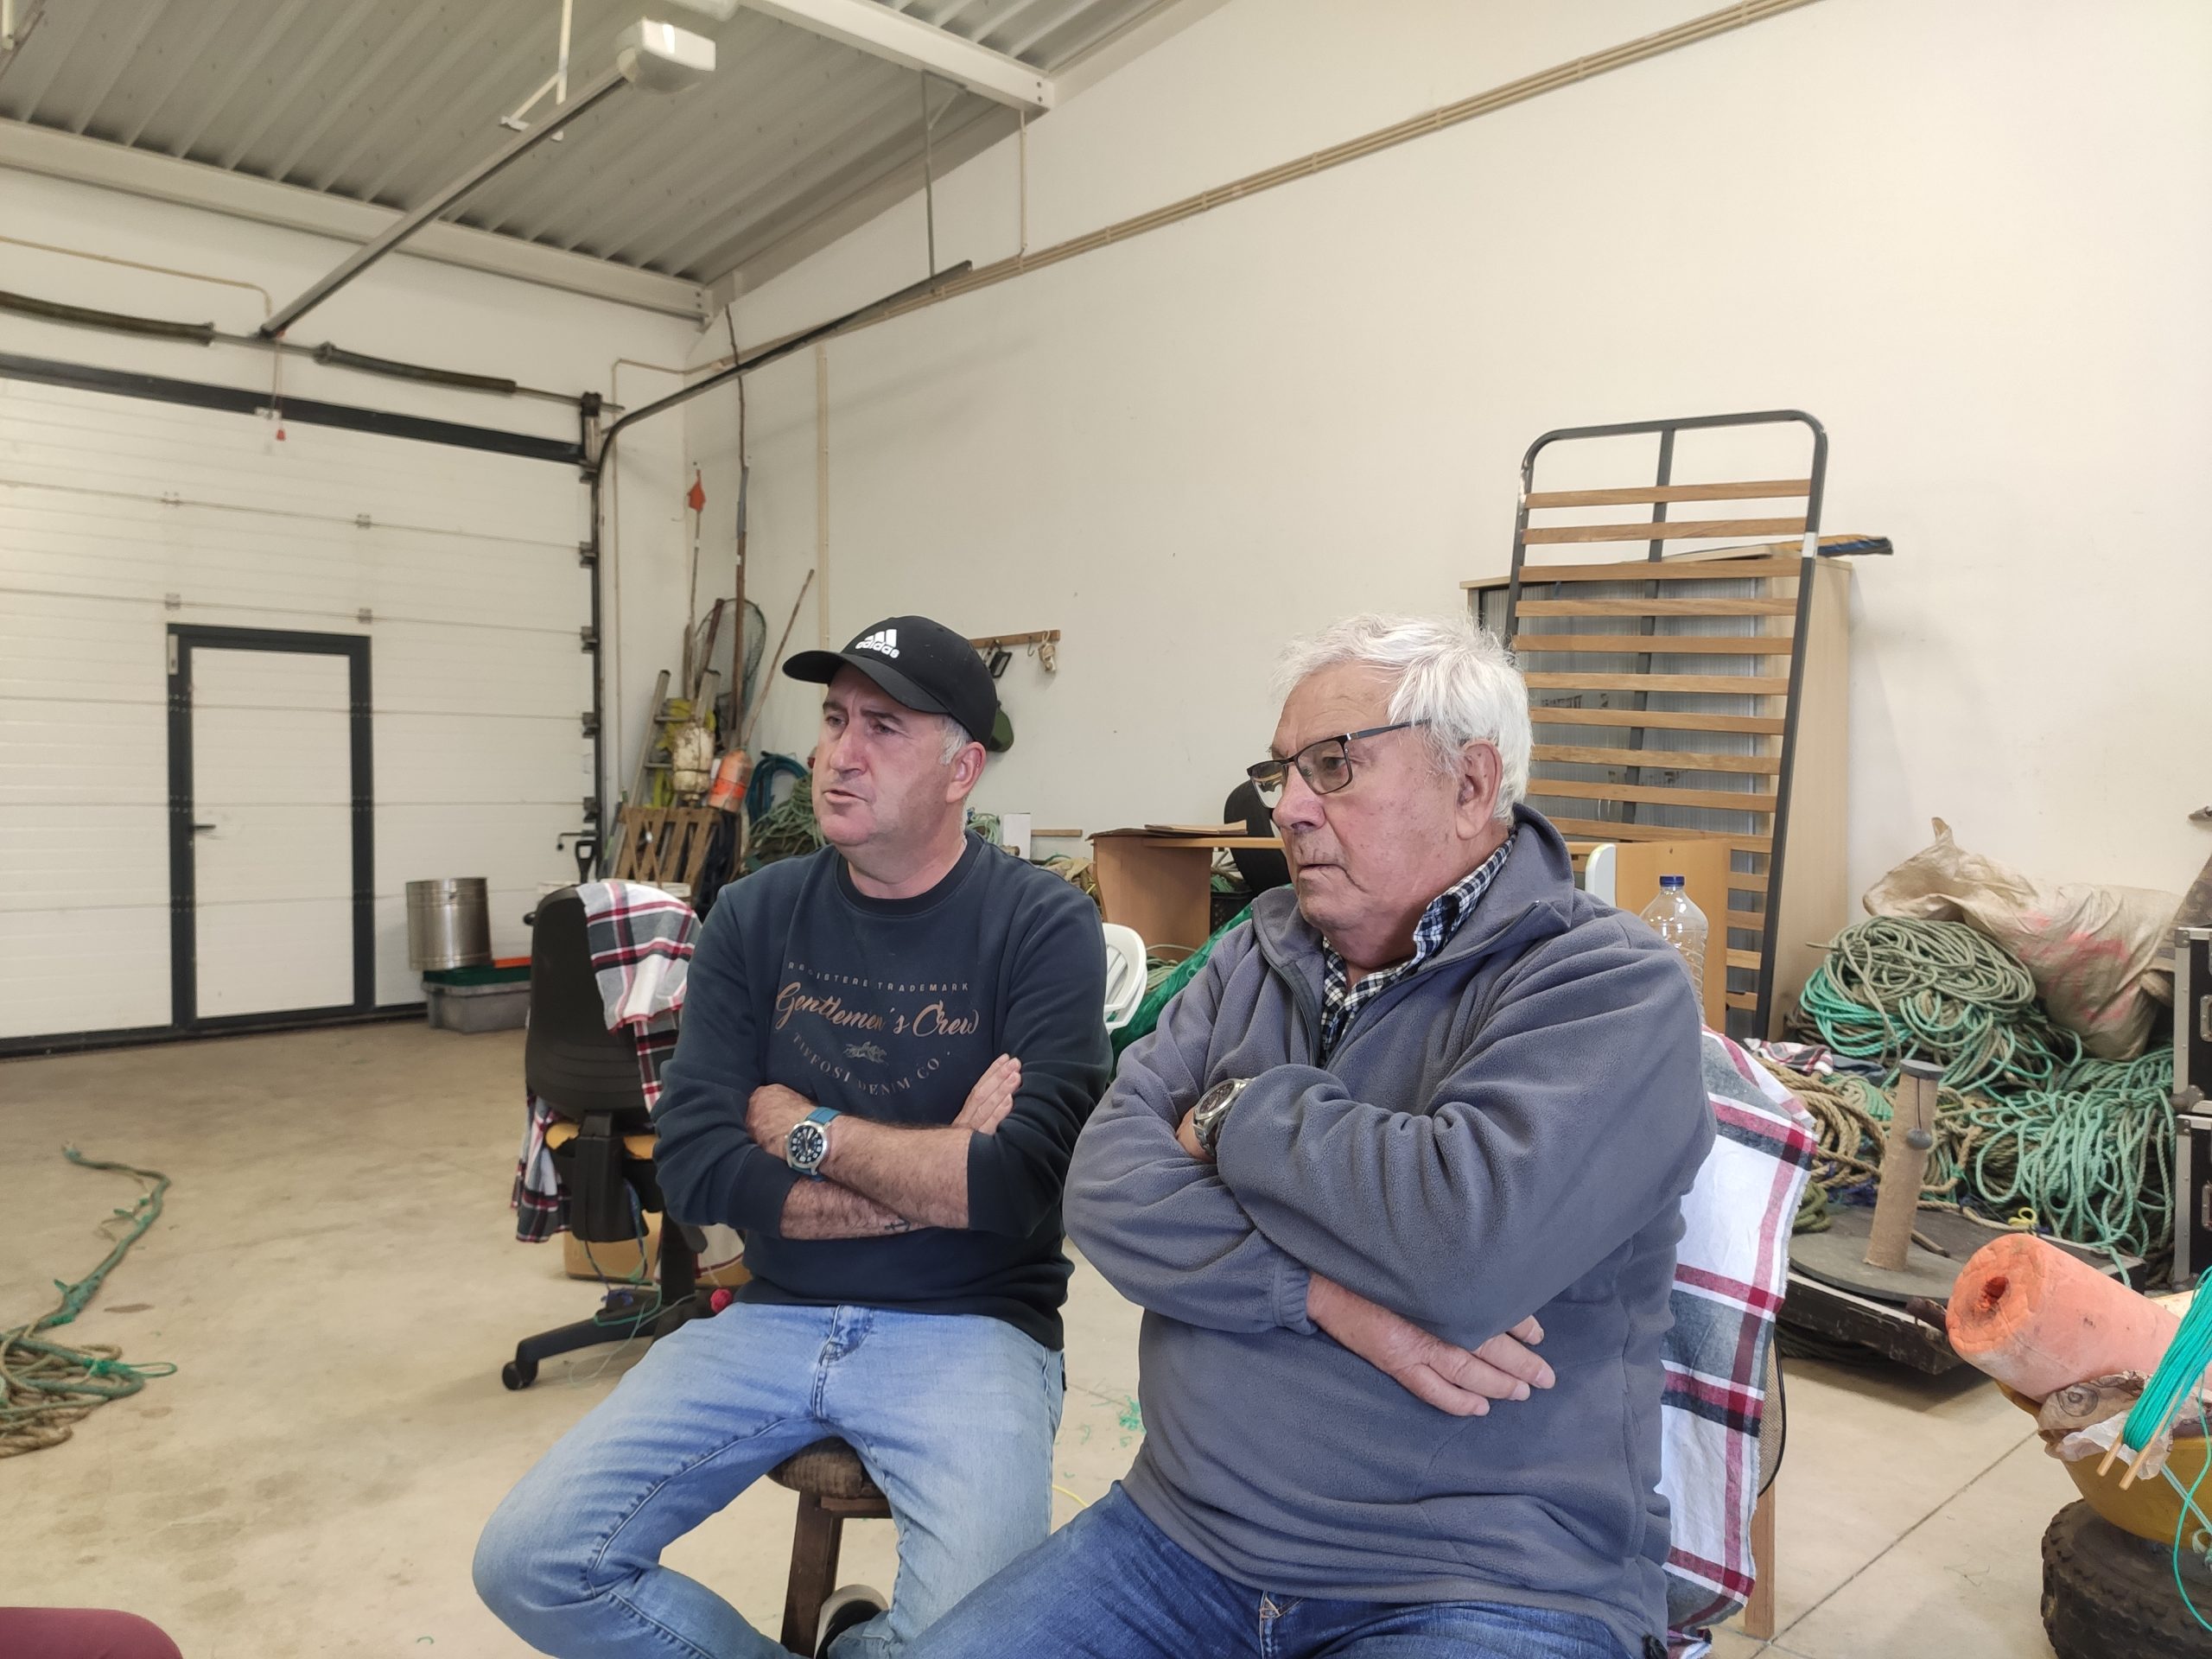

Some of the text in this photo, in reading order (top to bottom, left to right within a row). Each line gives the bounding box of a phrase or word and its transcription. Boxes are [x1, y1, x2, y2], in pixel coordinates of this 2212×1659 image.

[855, 639, 900, 659] adidas
[877, 981, 969, 993] TRADEMARK
[775, 981, 980, 1037] Gentlemen's Crew
[792, 1032, 851, 1083] TIFFOSI
[857, 1077, 911, 1096] DENIM
